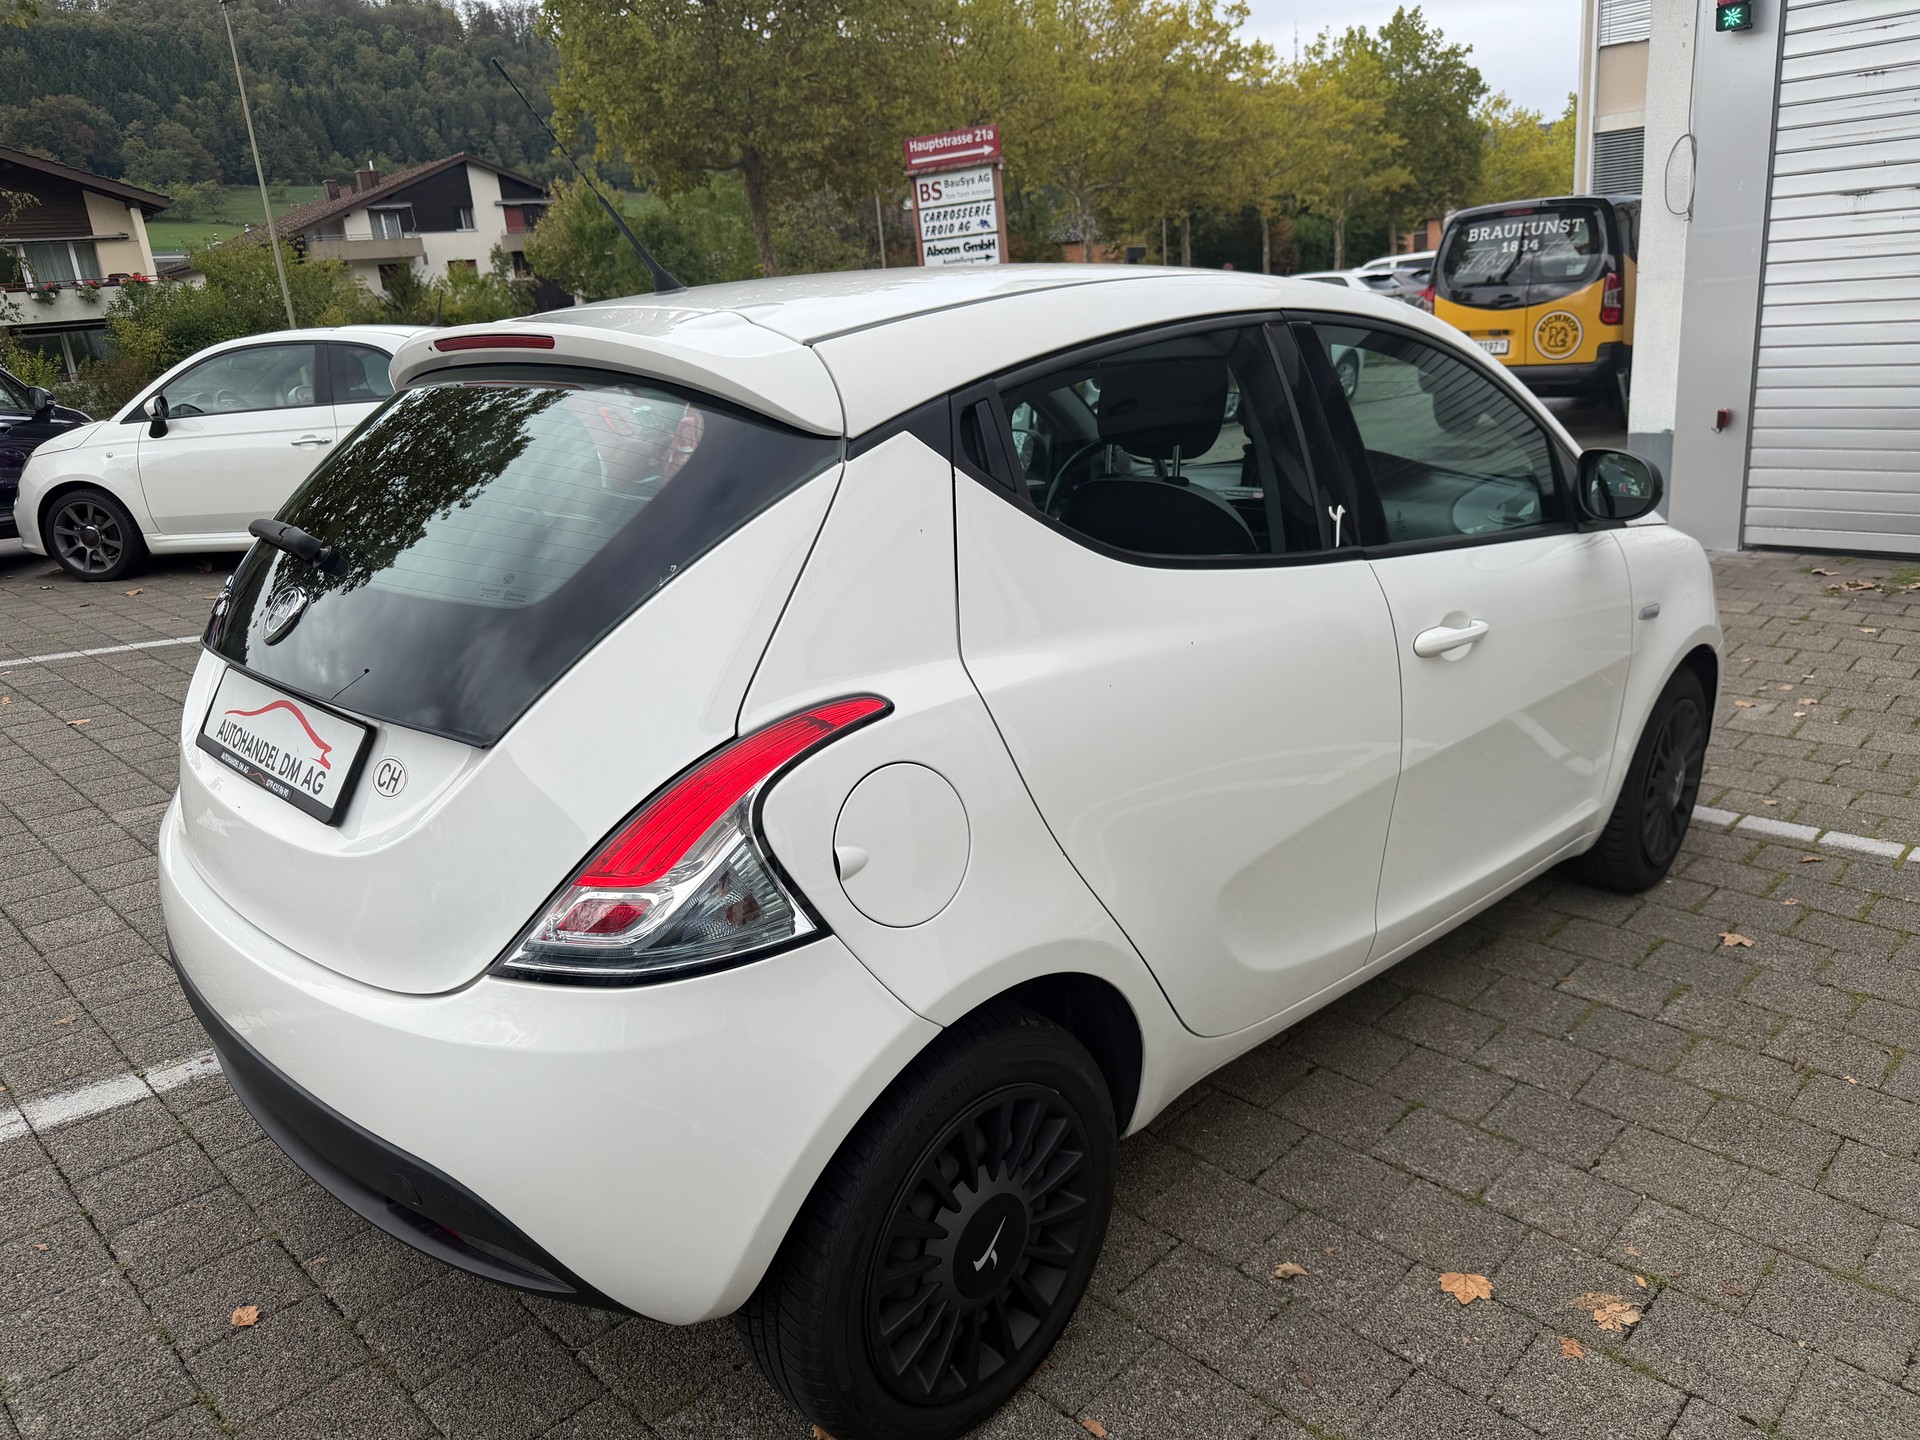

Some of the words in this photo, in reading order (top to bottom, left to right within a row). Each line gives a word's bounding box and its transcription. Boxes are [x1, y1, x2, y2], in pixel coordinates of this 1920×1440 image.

[909, 134, 973, 152] Hauptstrasse
[974, 129, 994, 142] 21a
[944, 176, 975, 189] BauSys
[977, 173, 991, 183] AG
[919, 181, 942, 202] BS
[923, 204, 992, 224] CARROSSERIE
[957, 221, 971, 233] AG
[1467, 218, 1585, 243] BRAUKUNST
[926, 245, 960, 258] Abcom
[963, 239, 996, 252] GmbH
[1501, 239, 1540, 253] 1834
[216, 719, 280, 771] AUTOHANDEL
[279, 753, 303, 783] DM
[301, 766, 327, 795] AG
[377, 763, 403, 793] CH
